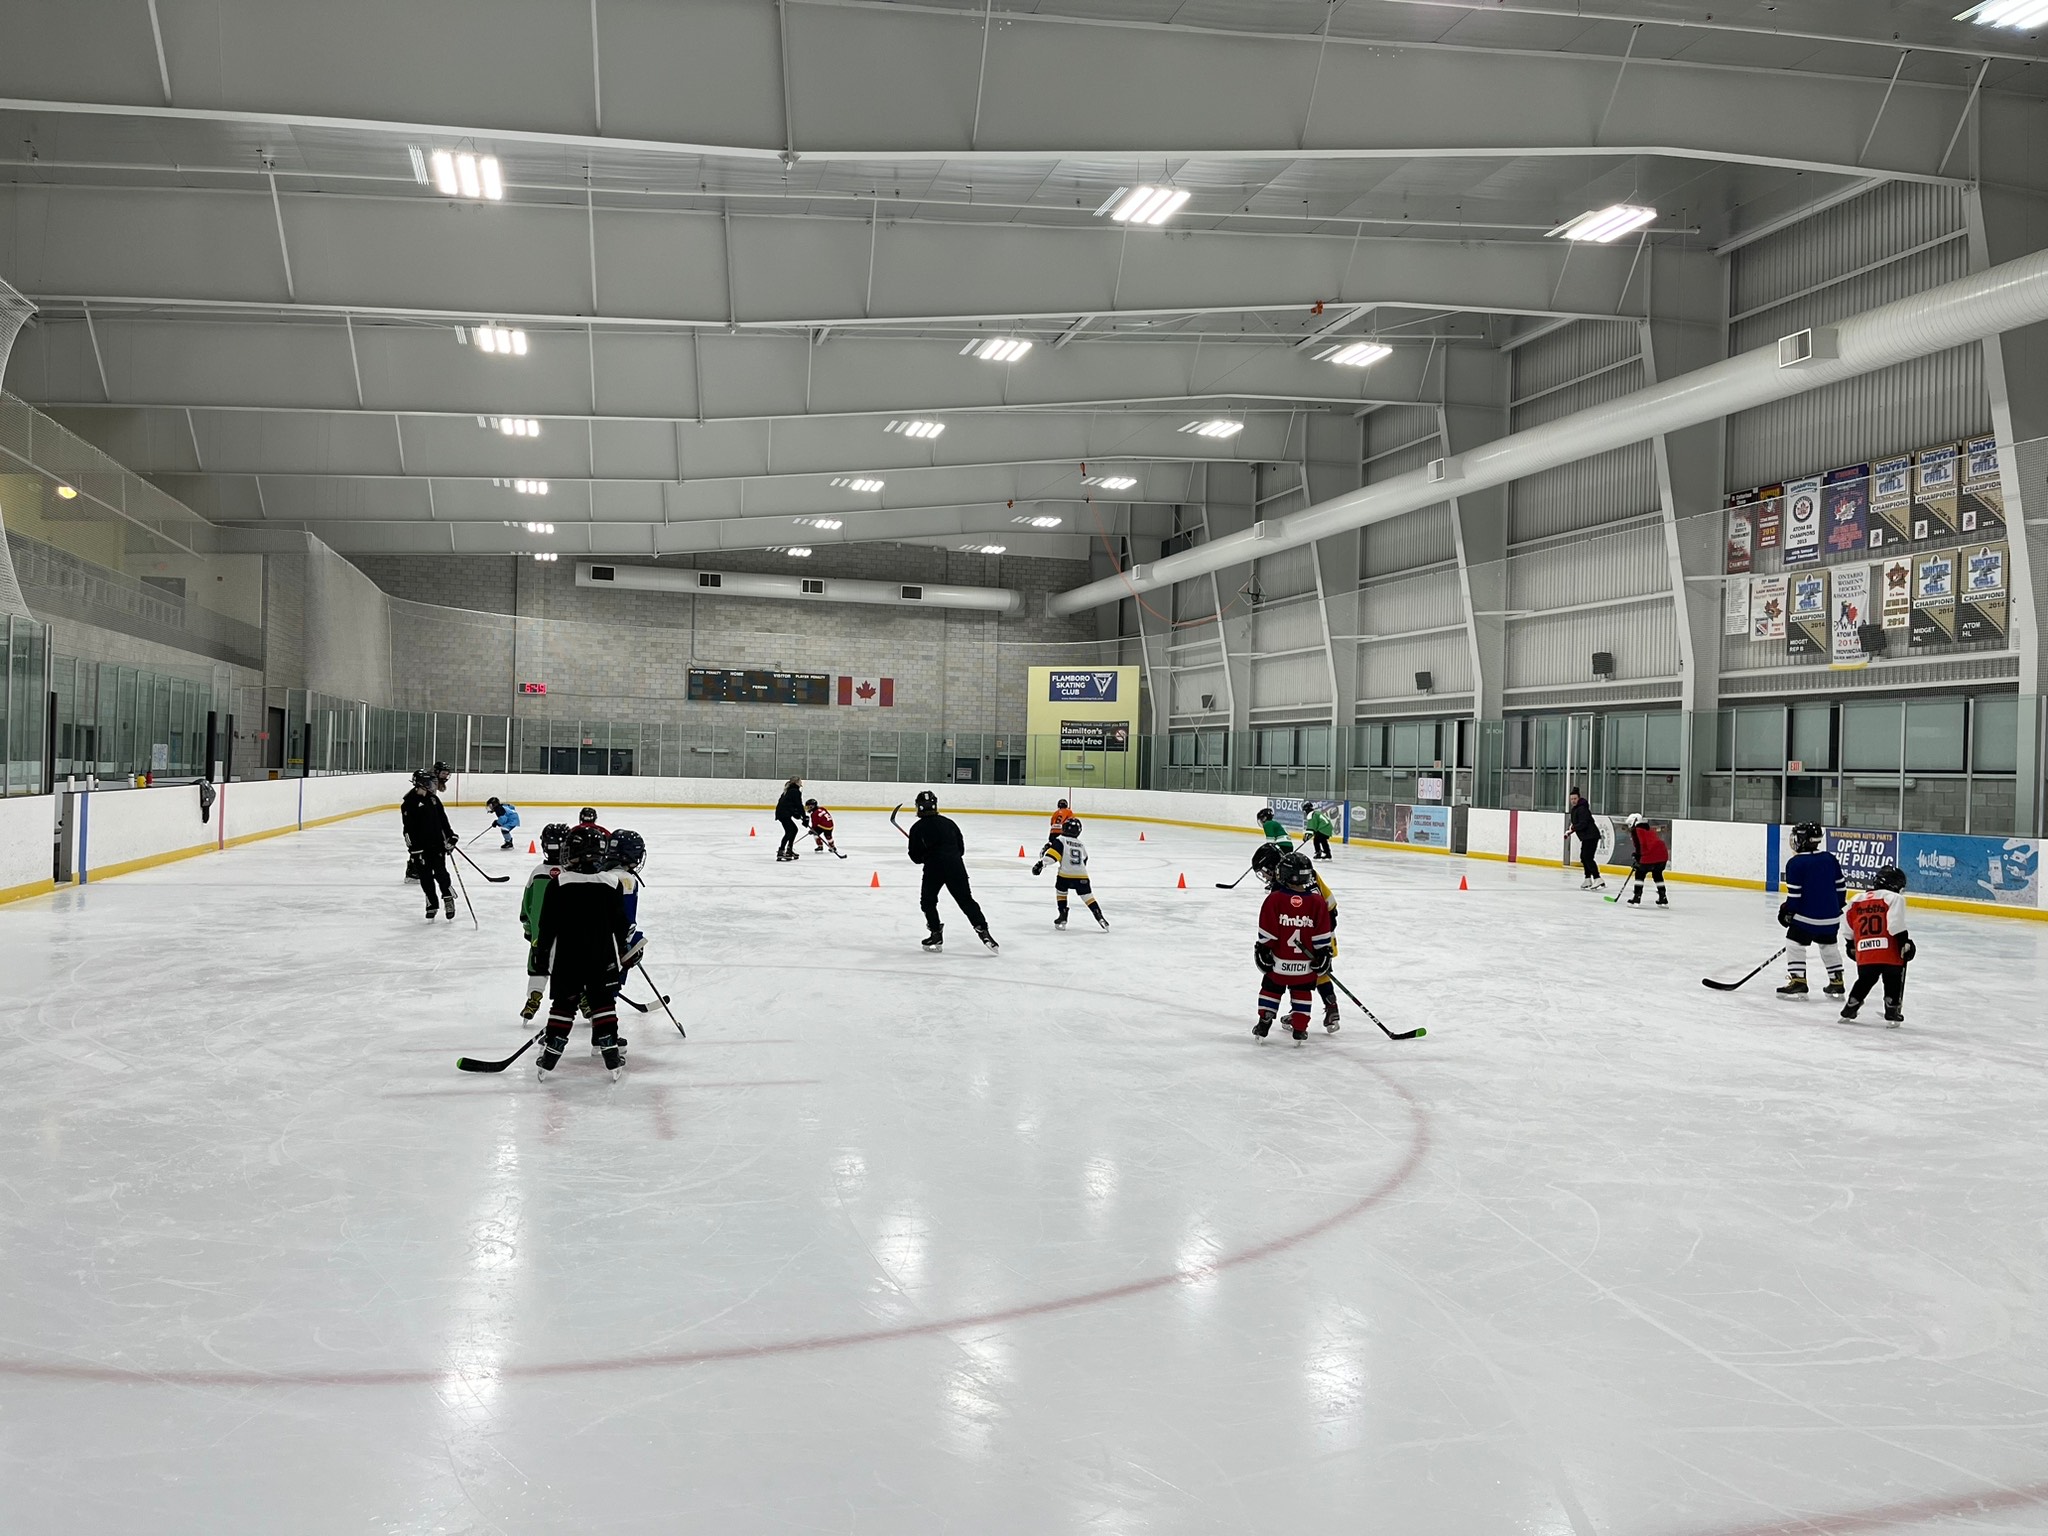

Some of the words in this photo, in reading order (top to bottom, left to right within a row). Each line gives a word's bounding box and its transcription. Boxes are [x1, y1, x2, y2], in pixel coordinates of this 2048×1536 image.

[1917, 490, 1956, 502] CHAMPIONS
[1872, 501, 1908, 512] CHAMPIONS
[1762, 527, 1775, 535] 2013
[1790, 530, 1815, 539] CHAMPIONS
[1971, 556, 1999, 567] WINTER
[1922, 564, 1949, 575] WINTER
[1798, 582, 1820, 591] WINTER
[1964, 591, 2004, 602] CHAMPIONS
[1915, 598, 1954, 608] CHAMPIONS
[1887, 617, 1905, 626] 2014
[1913, 626, 1935, 634] MIDGET
[1276, 800, 1303, 811] BOZEK
[1830, 831, 1861, 839] WATERDOWN
[1837, 839, 1868, 853] OPEN
[1870, 842, 1884, 855] TO
[1070, 848, 1081, 865] 9
[1852, 855, 1894, 869] PUBLIC
[1858, 915, 1882, 935] 20
[1287, 929, 1302, 953] 4
[1860, 939, 1880, 949] CANITO
[1282, 963, 1306, 971] SKITCH
